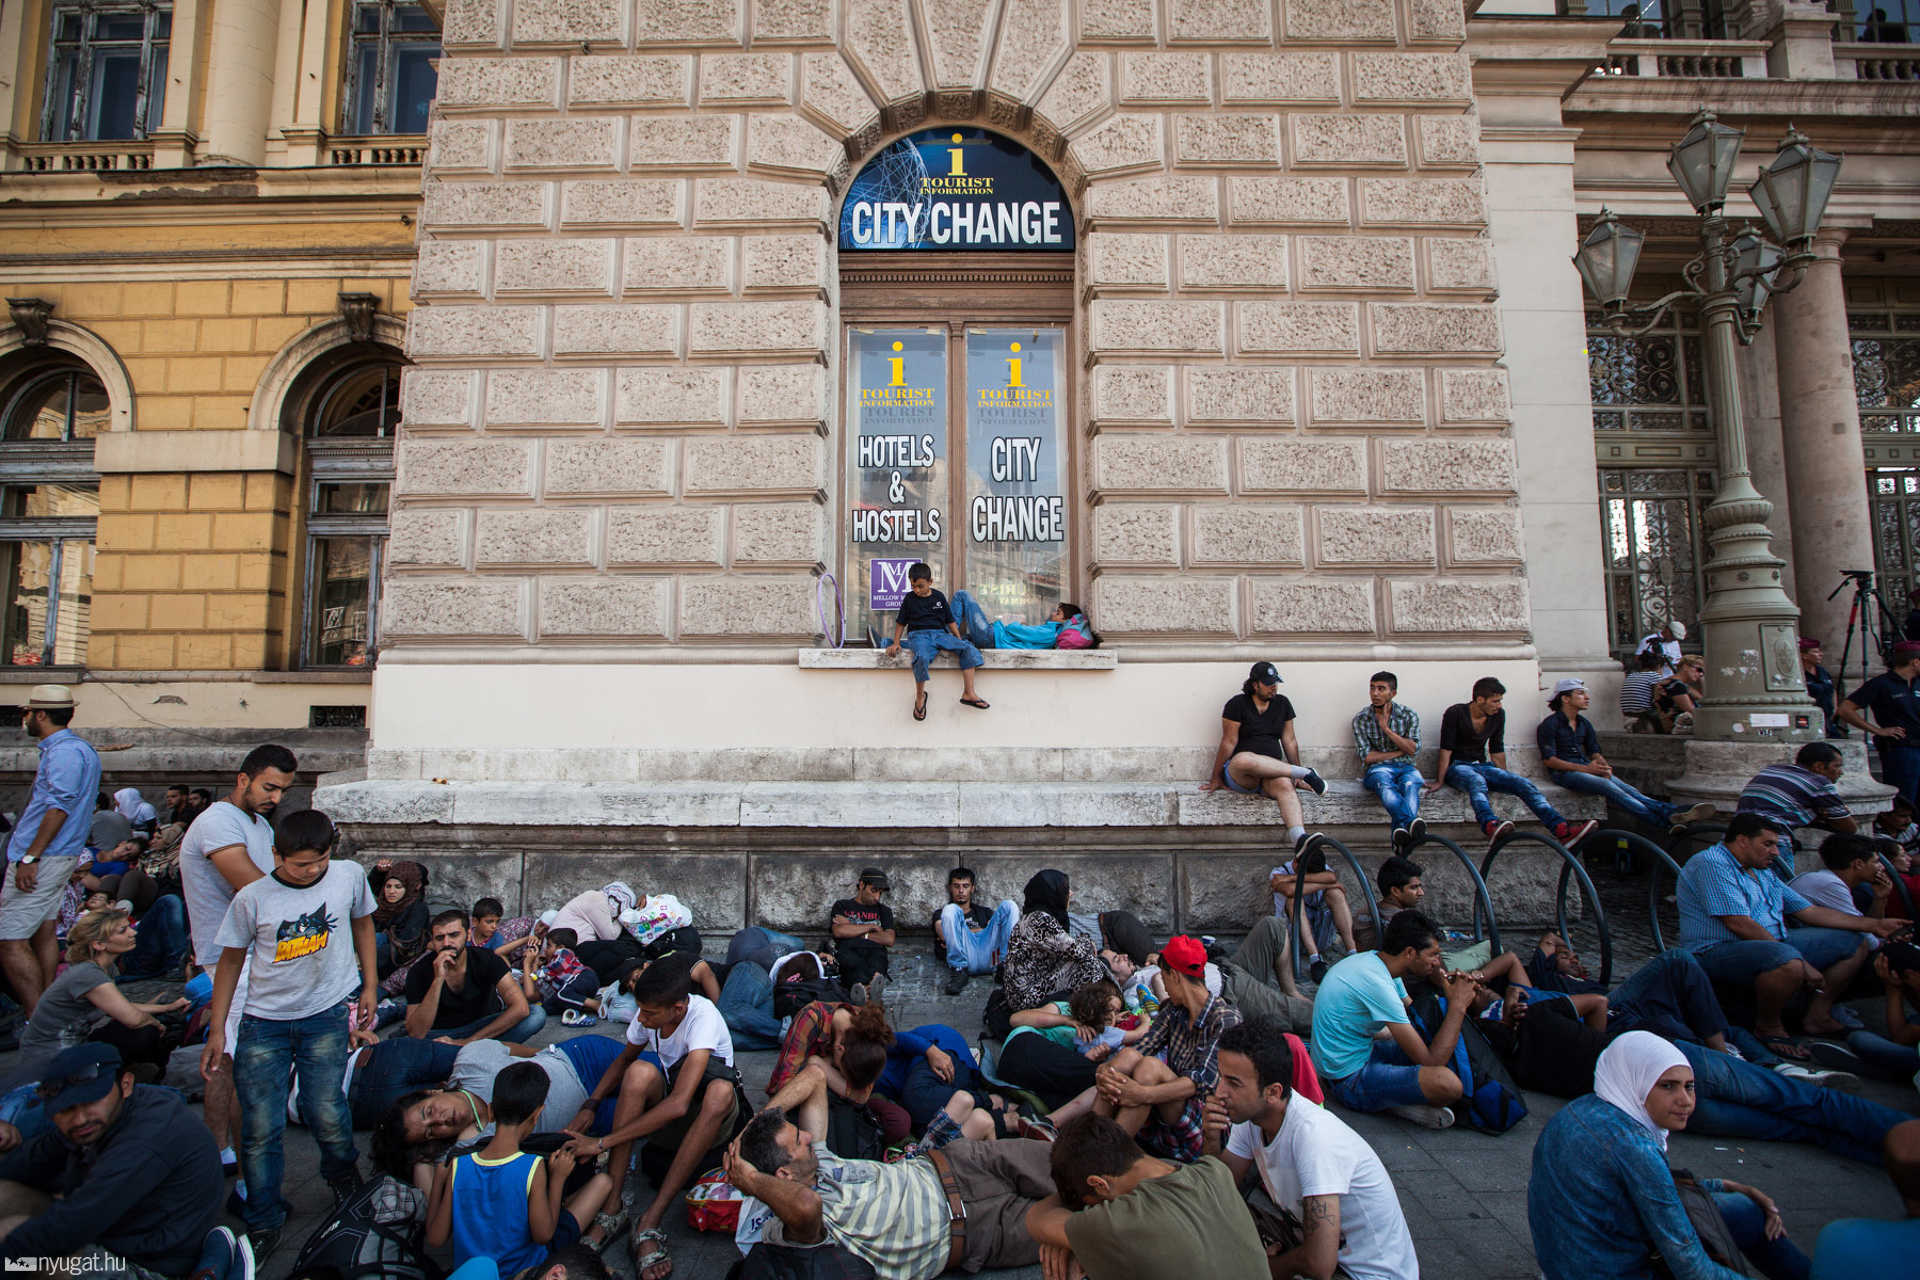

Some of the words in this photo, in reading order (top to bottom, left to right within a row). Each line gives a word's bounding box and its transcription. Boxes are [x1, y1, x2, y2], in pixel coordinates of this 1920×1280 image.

[920, 177, 994, 188] TOURIST
[852, 201, 924, 244] CITY
[931, 201, 1062, 244] CHANGE
[859, 400, 935, 408] INFORMATION
[861, 388, 935, 400] TOURIST
[977, 389, 1053, 401] TOURIST
[977, 400, 1053, 408] INFORMATION
[858, 434, 935, 468] HOTELS
[991, 436, 1042, 483] CITY
[888, 470, 906, 504] &
[851, 508, 941, 543] HOSTELS
[972, 495, 1065, 543] CHANGE
